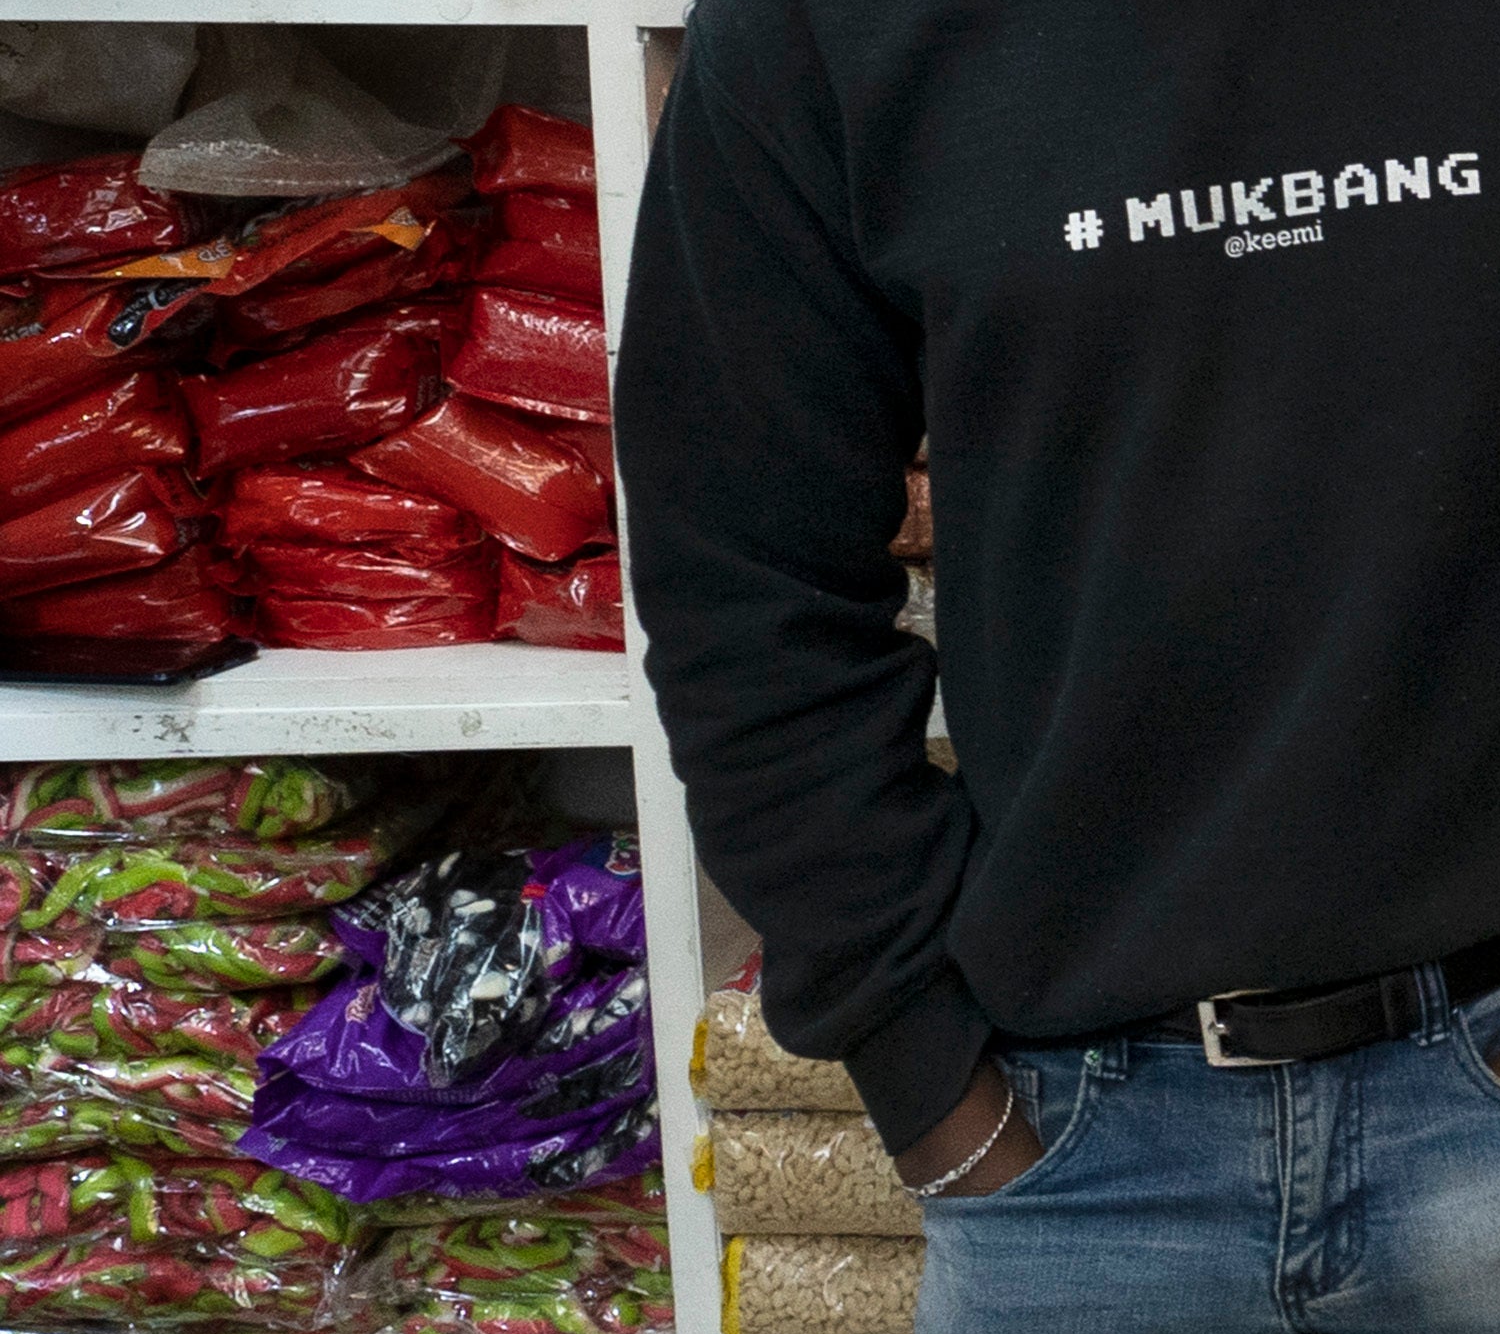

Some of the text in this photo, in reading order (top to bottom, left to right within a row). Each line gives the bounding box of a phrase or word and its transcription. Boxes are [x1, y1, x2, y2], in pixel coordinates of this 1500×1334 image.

[1063, 152, 1482, 252] # MUKBANG
[1224, 219, 1325, 258] @keemi
